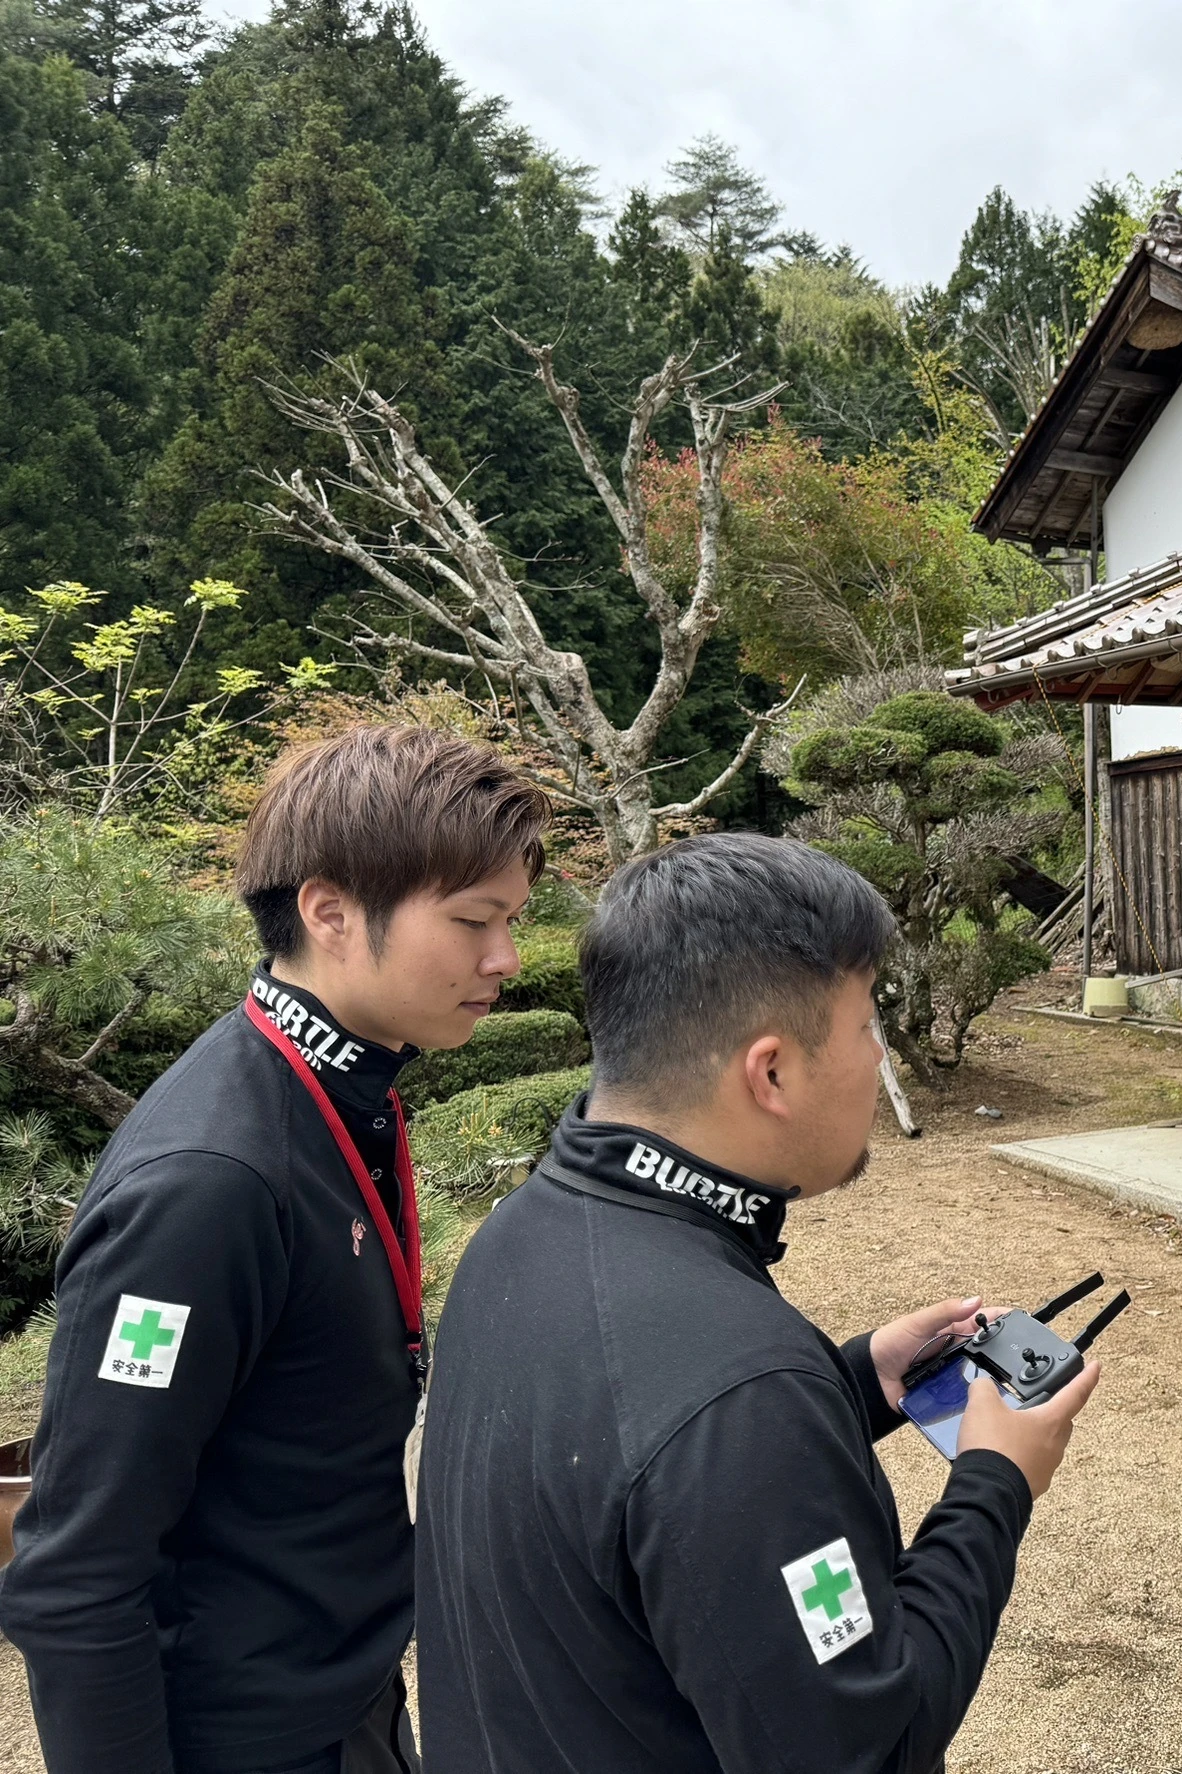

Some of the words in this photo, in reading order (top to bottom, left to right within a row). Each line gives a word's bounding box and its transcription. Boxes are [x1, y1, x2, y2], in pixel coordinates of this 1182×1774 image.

[112, 1359, 163, 1378] 安全第一
[819, 1616, 863, 1648] 安全第一
